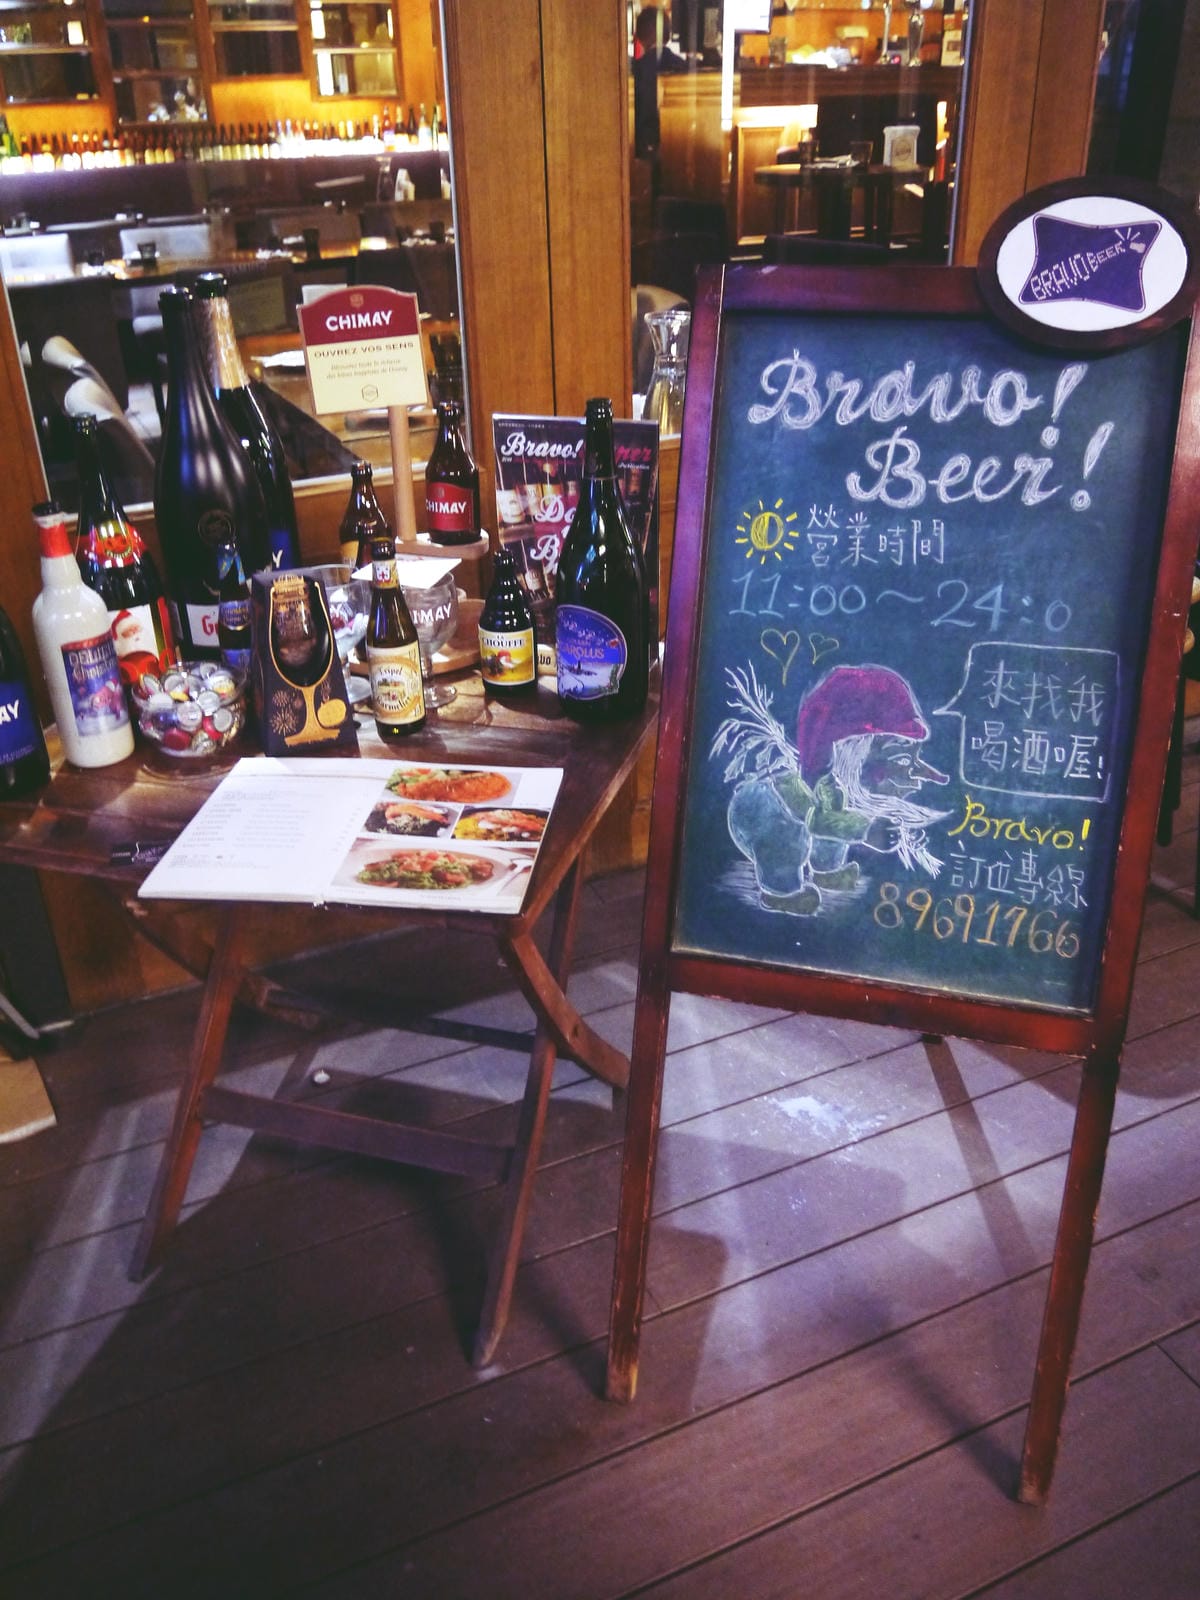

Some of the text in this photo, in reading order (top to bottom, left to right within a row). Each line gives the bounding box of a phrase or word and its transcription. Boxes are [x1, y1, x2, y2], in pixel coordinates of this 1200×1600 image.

[1030, 240, 1125, 300] BRAVO BEER
[314, 341, 414, 358] OUVREZ VOS SENS
[325, 310, 393, 332] CHIMAY
[747, 348, 1088, 449] Bravo!
[501, 431, 584, 458] Bravo!
[845, 421, 1114, 511] Beer!
[807, 503, 945, 567] 營業時間
[410, 603, 451, 625] IMAY
[980, 660, 1106, 726] 來找我
[948, 794, 1090, 850] Bravo!
[873, 882, 1080, 958] 89691766
